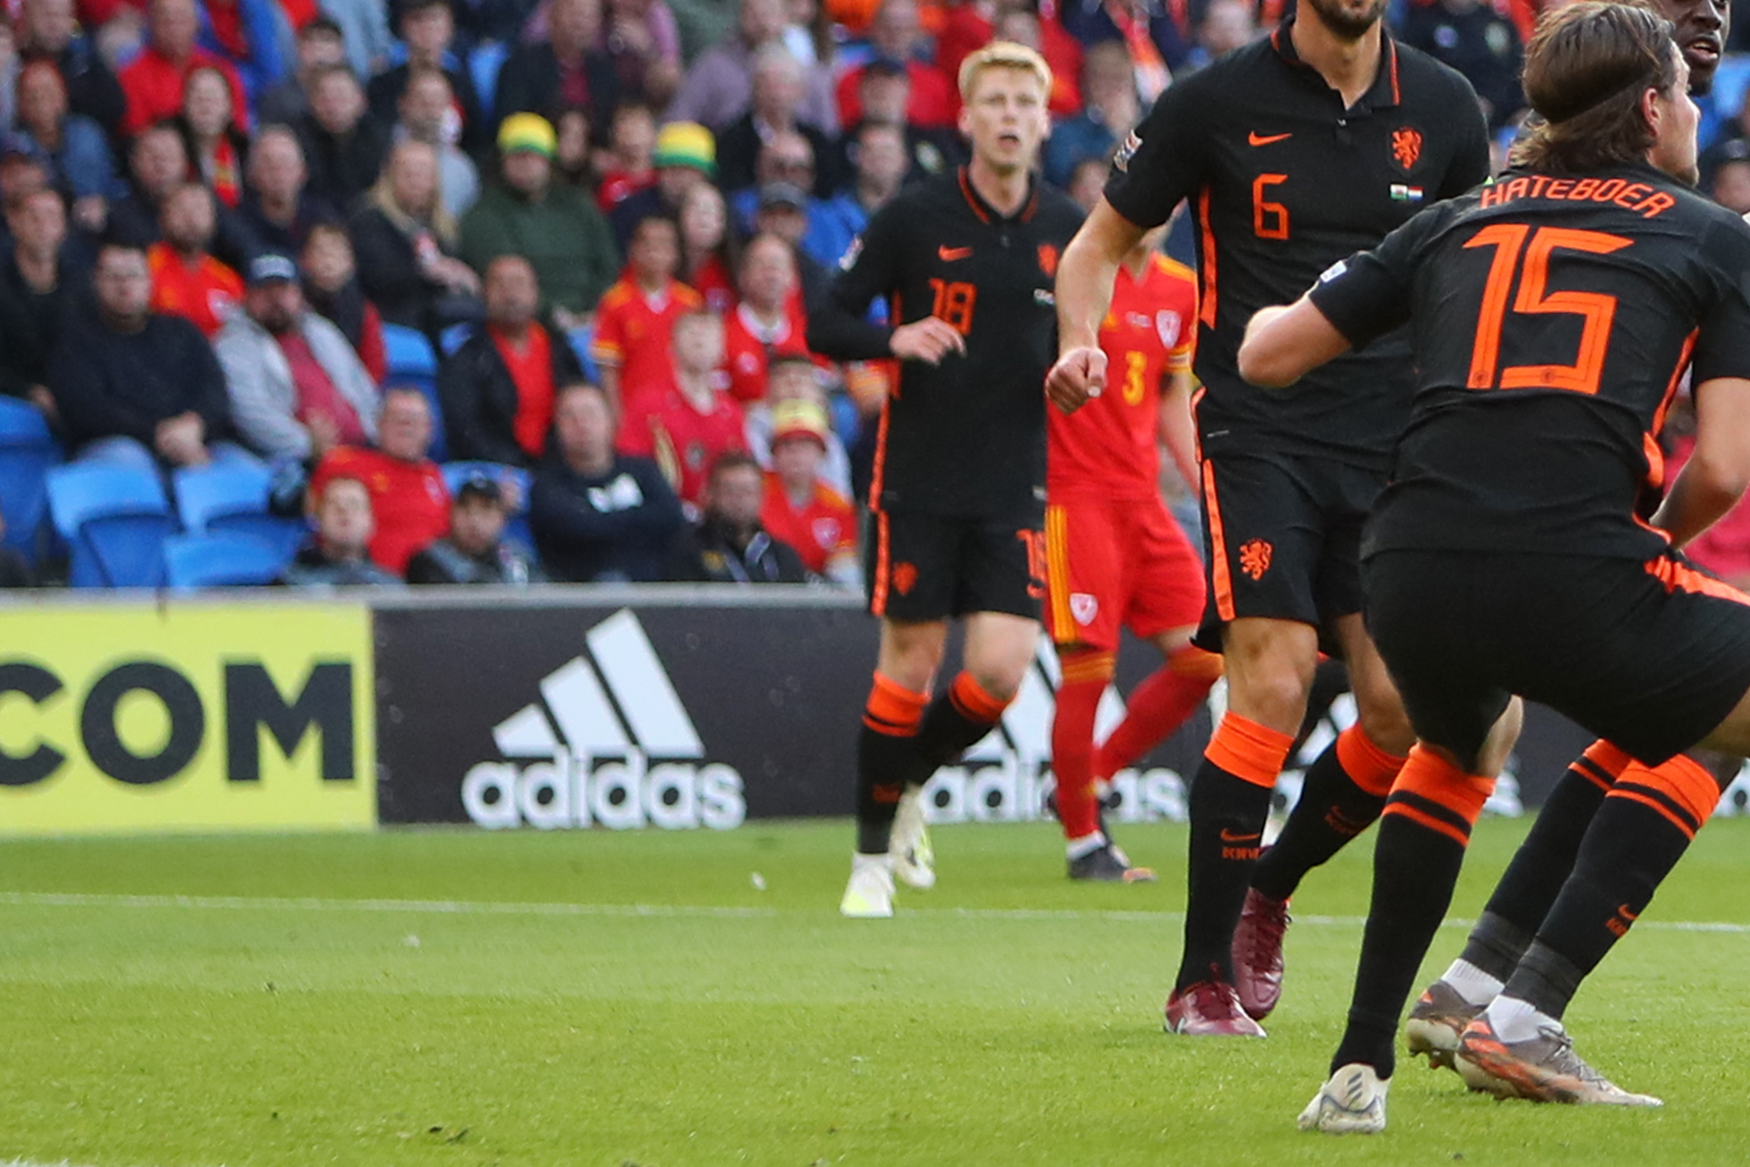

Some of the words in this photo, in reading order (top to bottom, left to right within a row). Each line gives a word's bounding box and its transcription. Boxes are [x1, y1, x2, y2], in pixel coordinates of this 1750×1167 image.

[1252, 173, 1288, 240] 6
[1480, 175, 1676, 218] HATEBOER
[929, 277, 977, 336] 18
[1462, 223, 1636, 395] 15
[1122, 350, 1148, 406] 3
[461, 745, 747, 830] adidas
[919, 747, 1188, 823] adias
